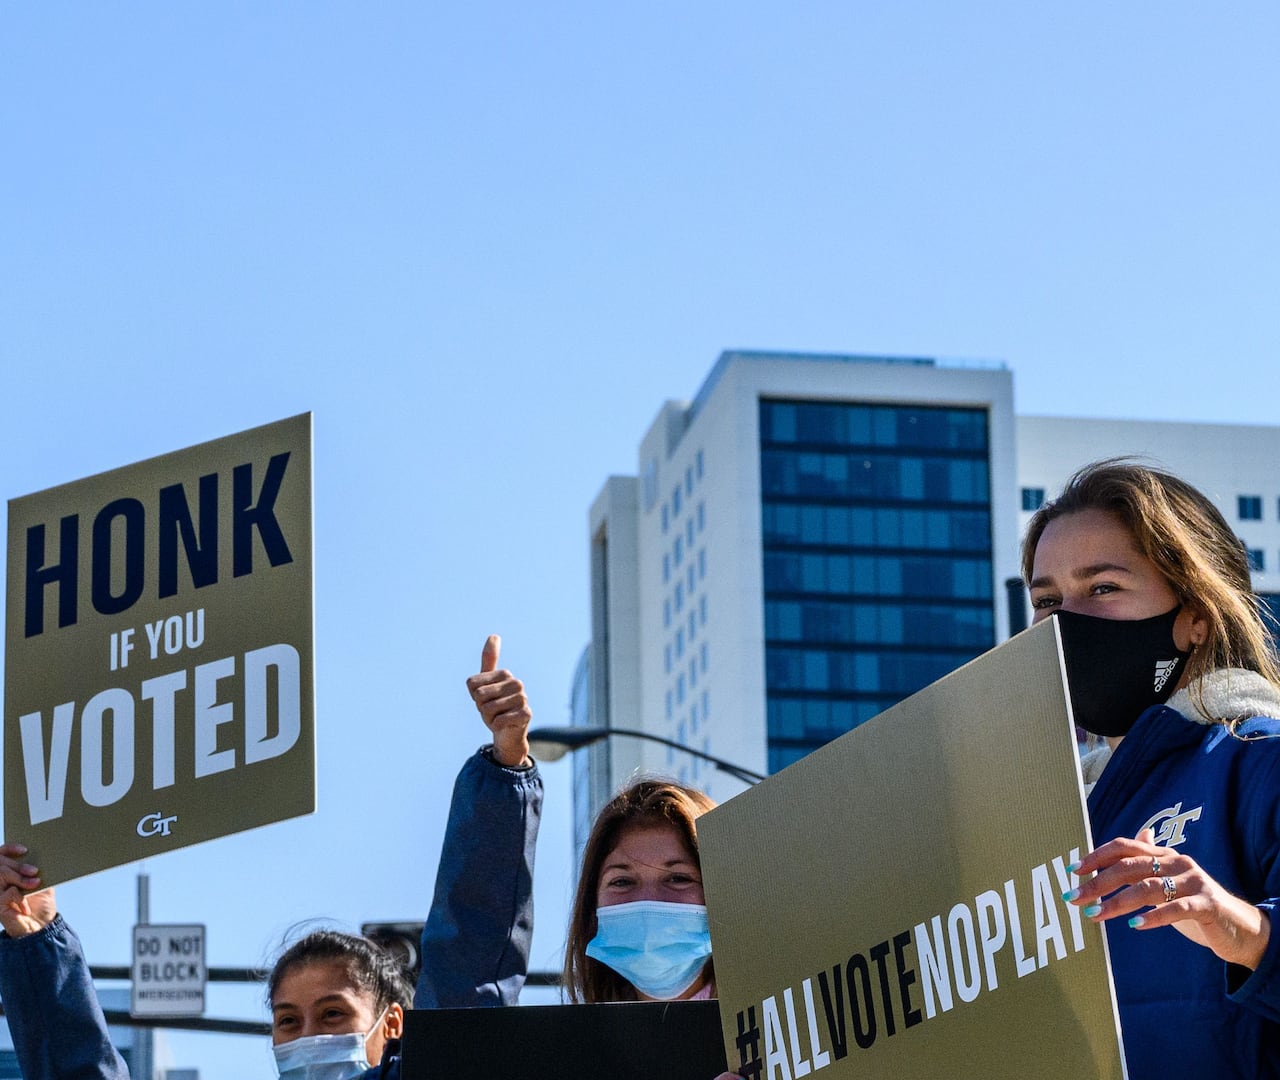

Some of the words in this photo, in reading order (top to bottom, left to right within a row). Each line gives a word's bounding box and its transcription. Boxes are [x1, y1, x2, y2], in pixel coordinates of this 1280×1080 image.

[24, 451, 294, 639] HONK
[109, 627, 135, 671] IF
[144, 608, 205, 660] YOU
[1154, 656, 1180, 693] adidas
[18, 642, 302, 826] VOTED
[135, 811, 178, 838] GT
[136, 937, 161, 956] DO
[168, 936, 201, 956] NOT
[140, 962, 200, 981] BLOCK
